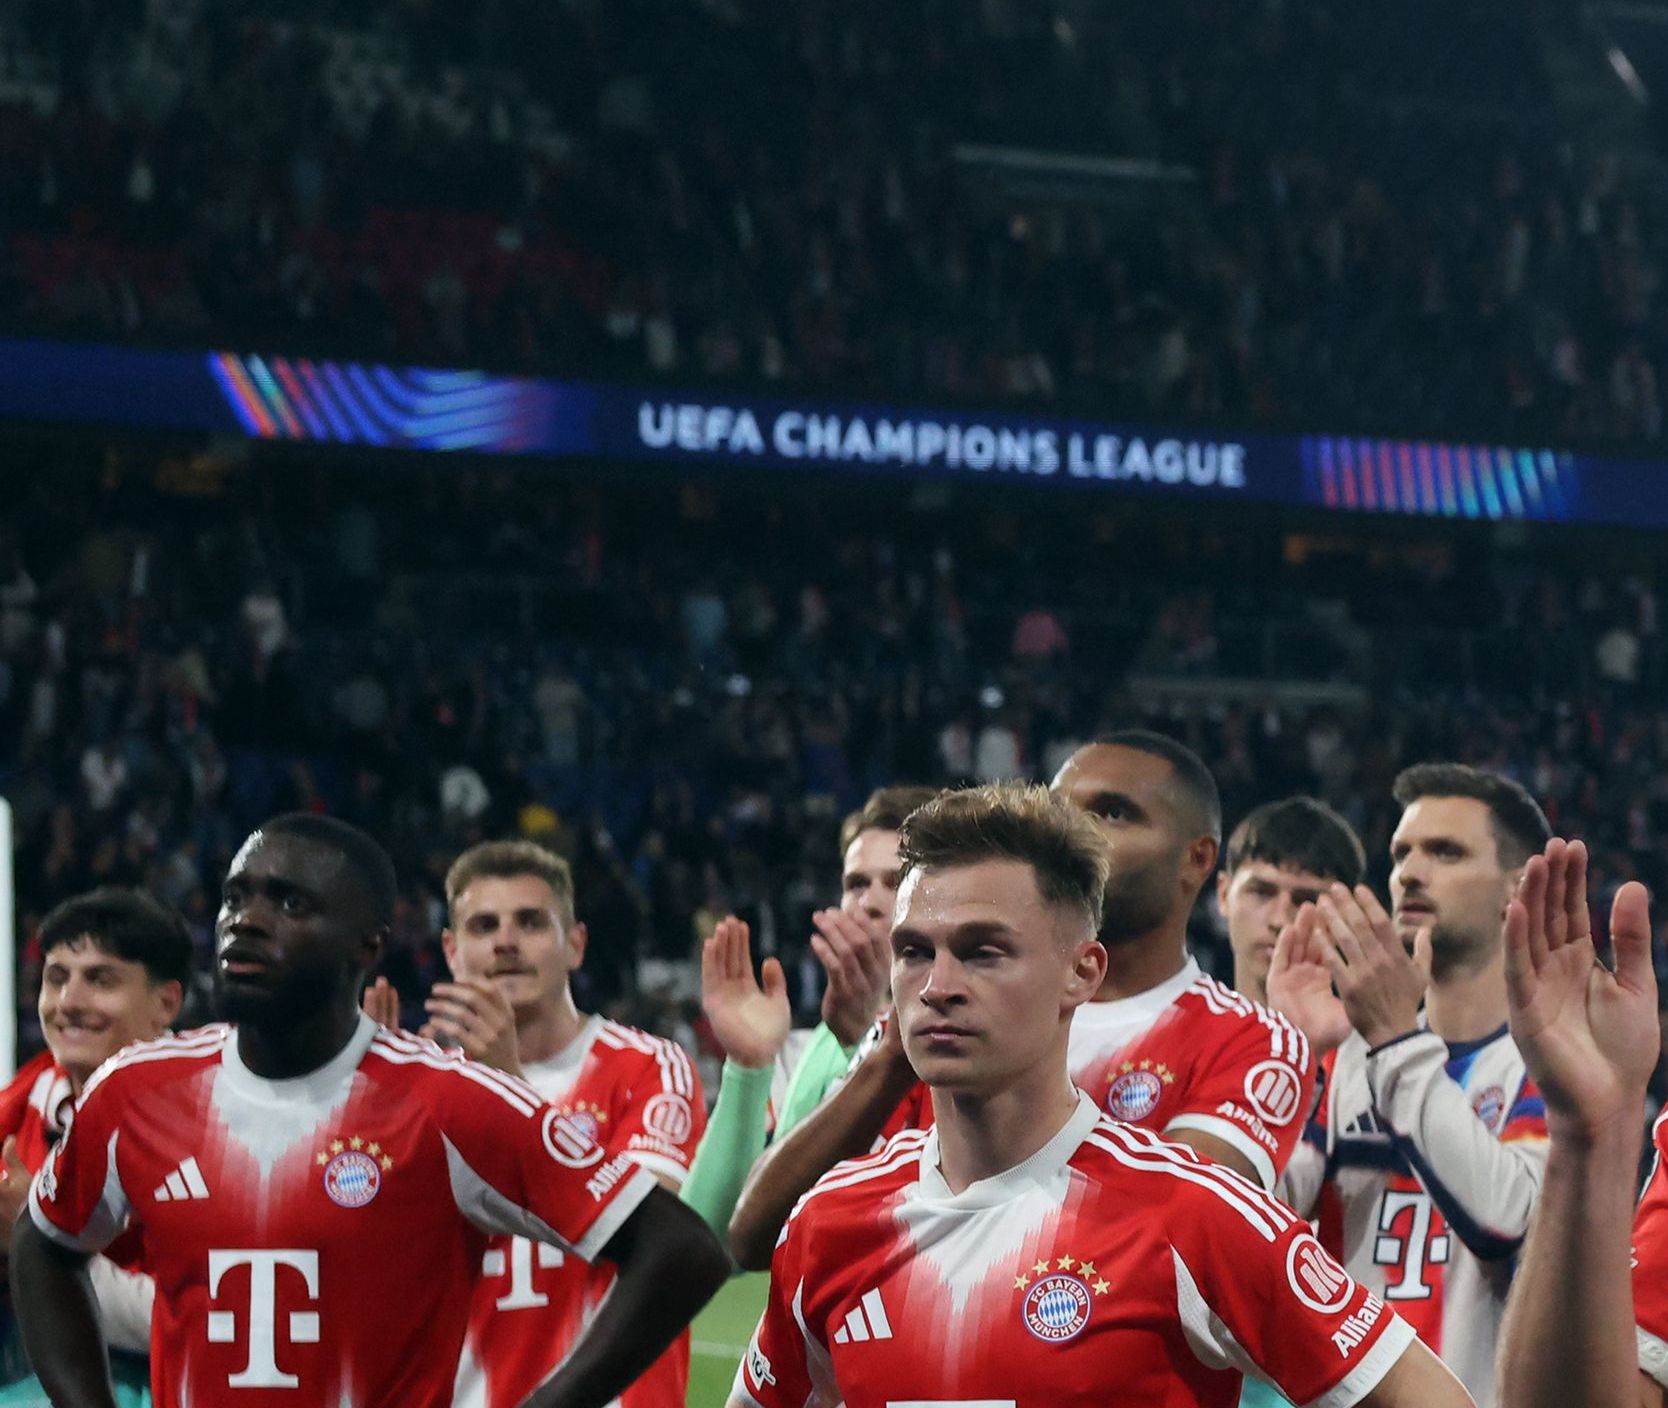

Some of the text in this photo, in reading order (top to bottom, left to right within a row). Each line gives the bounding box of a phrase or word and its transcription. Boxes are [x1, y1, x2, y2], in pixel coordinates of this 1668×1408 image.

[639, 402, 1246, 487] UEFA CHAMPIONS LEAGUE
[1030, 1279, 1087, 1307] FC BAYERN
[1374, 1191, 1451, 1301] T
[208, 1249, 320, 1388] T
